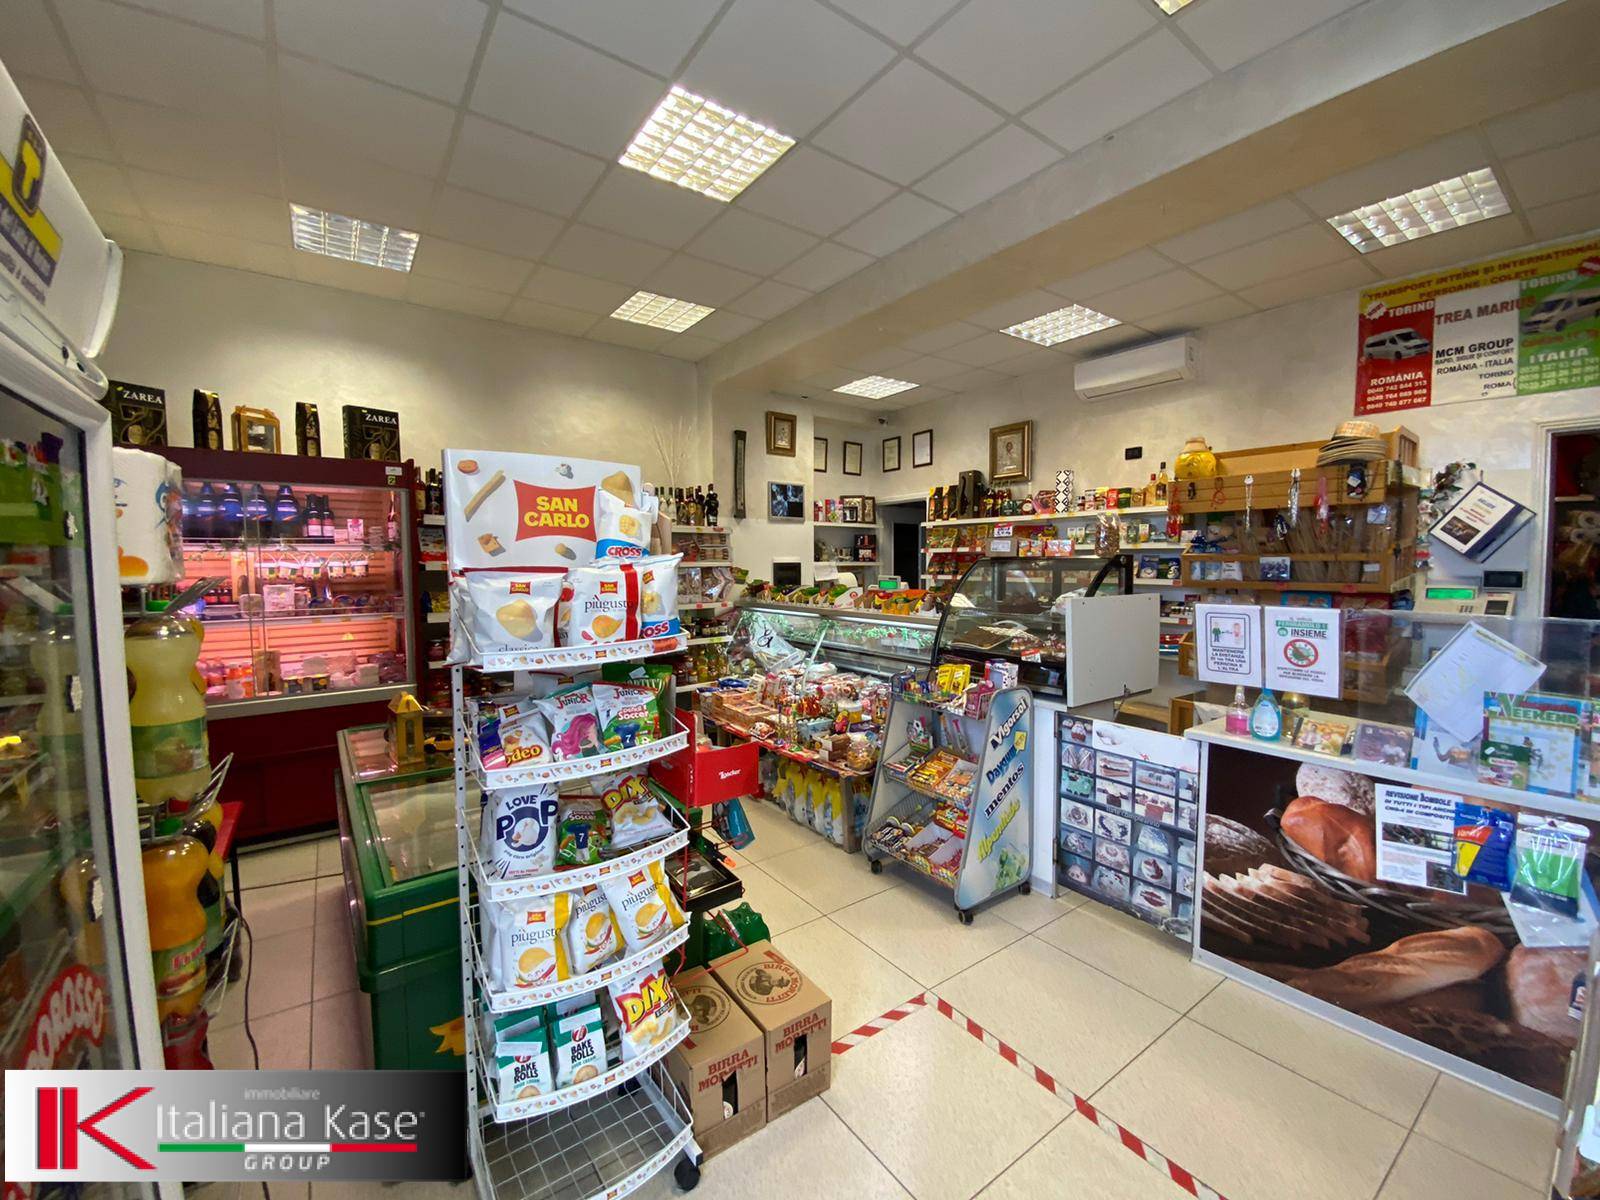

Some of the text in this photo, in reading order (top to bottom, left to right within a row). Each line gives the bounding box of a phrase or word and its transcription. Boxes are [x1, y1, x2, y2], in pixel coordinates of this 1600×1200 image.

[1520, 270, 1578, 290] TORINO
[1368, 280, 1433, 300] TRANSPORT
[1389, 300, 1435, 317] TORINO
[1435, 308, 1473, 325] TREA
[1435, 346, 1465, 358] MCM
[1468, 337, 1514, 353] GROUP
[1485, 357, 1514, 368] ITALIA
[1479, 369, 1514, 379] TORINO
[1483, 381, 1512, 390] ROMA
[122, 389, 163, 405] ZAREA
[365, 413, 397, 425] ZAREA
[536, 496, 578, 512] SAN
[523, 510, 590, 529] CARLO
[607, 546, 642, 557] CROSS
[641, 621, 669, 638] OSS
[1291, 629, 1327, 639] INSIEME
[555, 692, 591, 709] JUNIOR
[617, 711, 649, 720] Soccer
[989, 697, 1028, 750] Vigorsol
[625, 734, 631, 743] 7
[985, 763, 1024, 817] mentos
[505, 795, 538, 811] LOVE
[496, 800, 558, 852] POP
[578, 832, 585, 842] 7
[575, 892, 607, 918] piùgust
[511, 925, 562, 947] piùgusto
[783, 1013, 820, 1037] BIRRA
[571, 1039, 593, 1052] BAKE
[571, 1048, 595, 1063] ROLLS
[708, 1049, 749, 1076] BIRRA
[514, 1062, 537, 1075] BAKE
[514, 1071, 539, 1083] ROLLS
